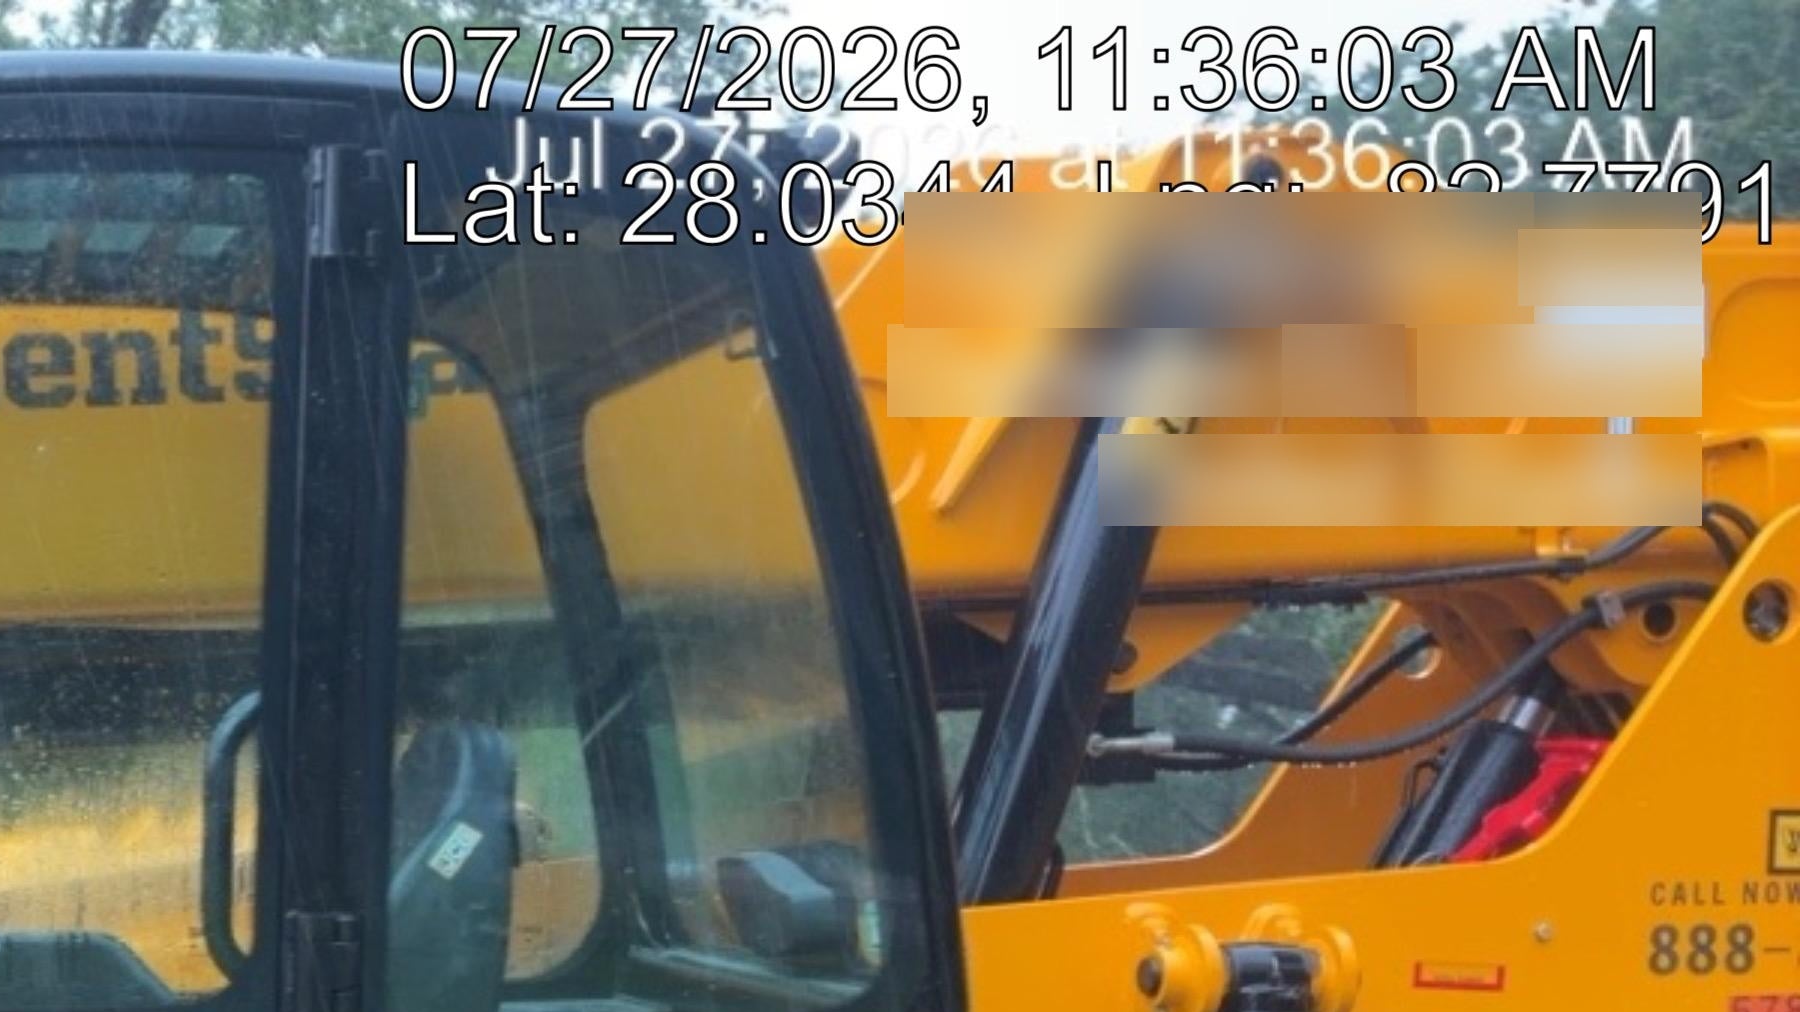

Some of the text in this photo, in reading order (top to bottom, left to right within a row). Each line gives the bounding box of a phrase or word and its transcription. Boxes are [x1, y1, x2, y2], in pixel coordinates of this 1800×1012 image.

[1649, 880, 1800, 905] CALL NOW
[1648, 923, 1800, 976] 888-
